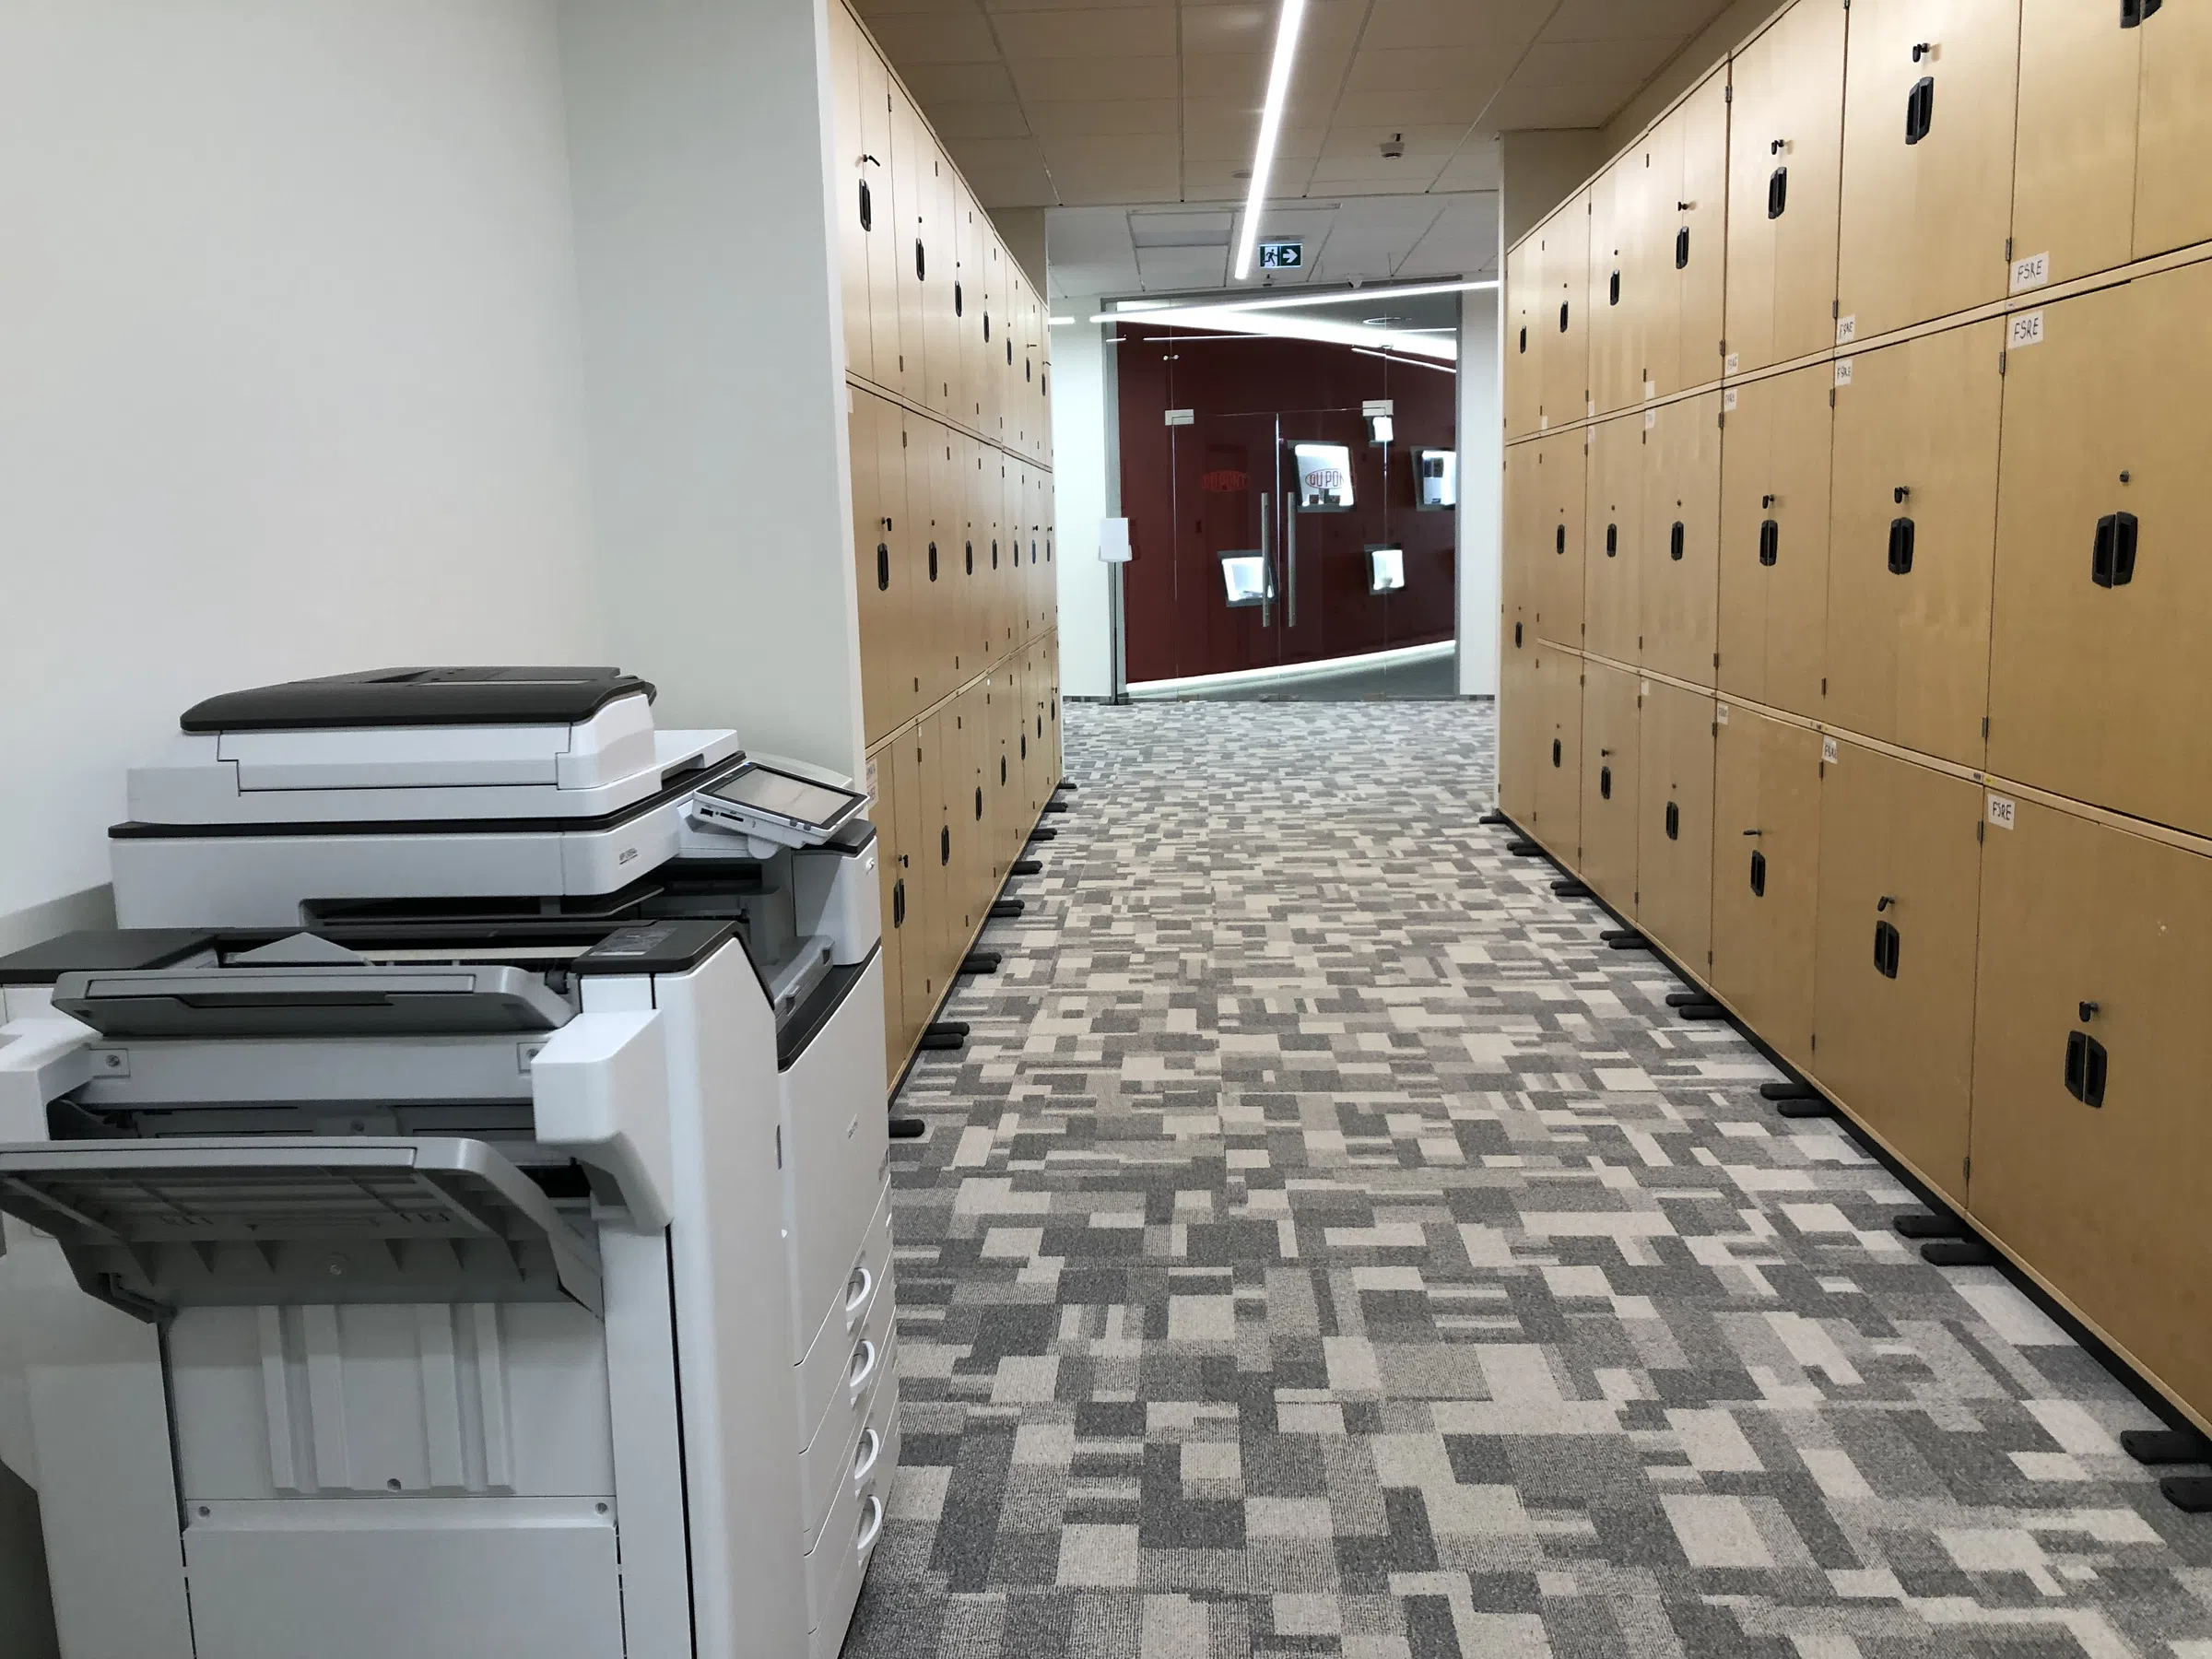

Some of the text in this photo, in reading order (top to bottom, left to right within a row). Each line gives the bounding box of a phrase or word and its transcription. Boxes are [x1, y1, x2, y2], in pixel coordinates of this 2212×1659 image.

[2017, 259, 2042, 283] FSRE
[2014, 317, 2039, 341] FSRE
[1992, 801, 2012, 821] FSRE
